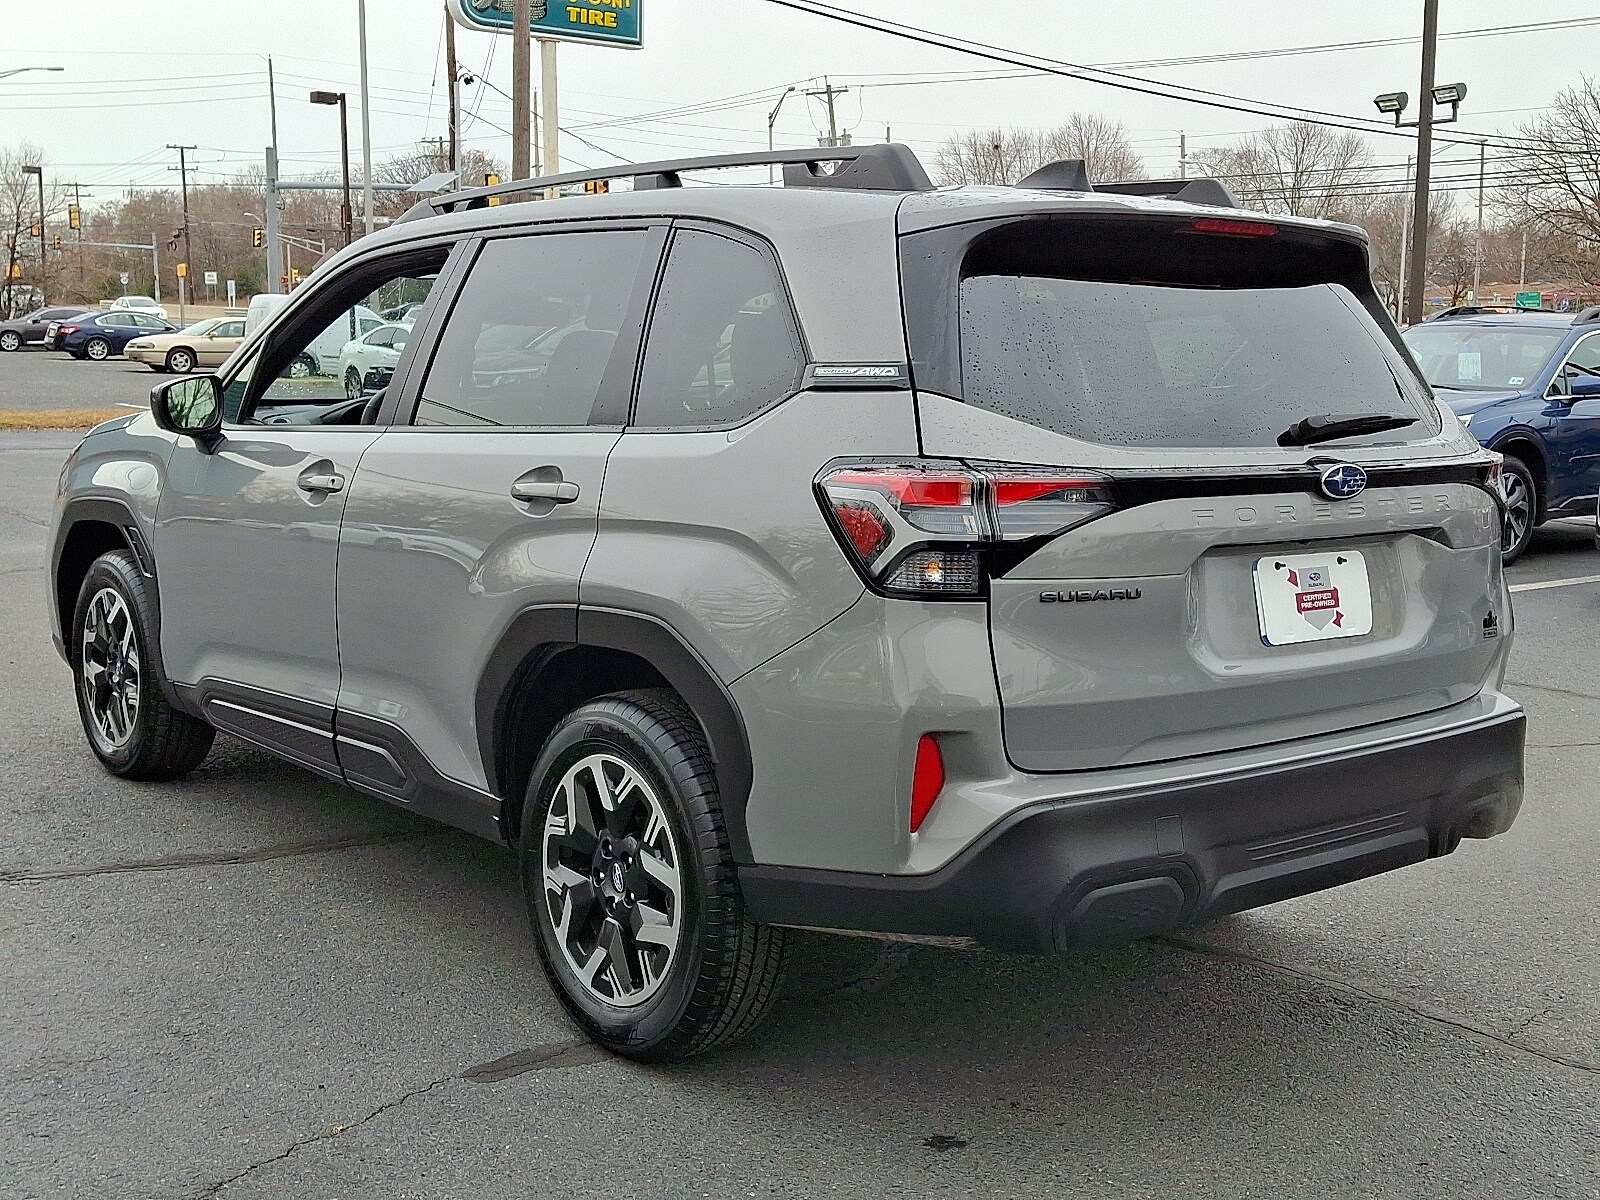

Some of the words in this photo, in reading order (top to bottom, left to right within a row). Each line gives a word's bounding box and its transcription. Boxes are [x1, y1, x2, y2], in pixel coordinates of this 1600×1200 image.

[566, 6, 617, 27] TIRE
[1191, 494, 1452, 526] FORESTER
[1039, 587, 1142, 603] SUBARU
[1303, 593, 1332, 601] CERTIFIED
[1301, 600, 1335, 609] PRE-OWNED
